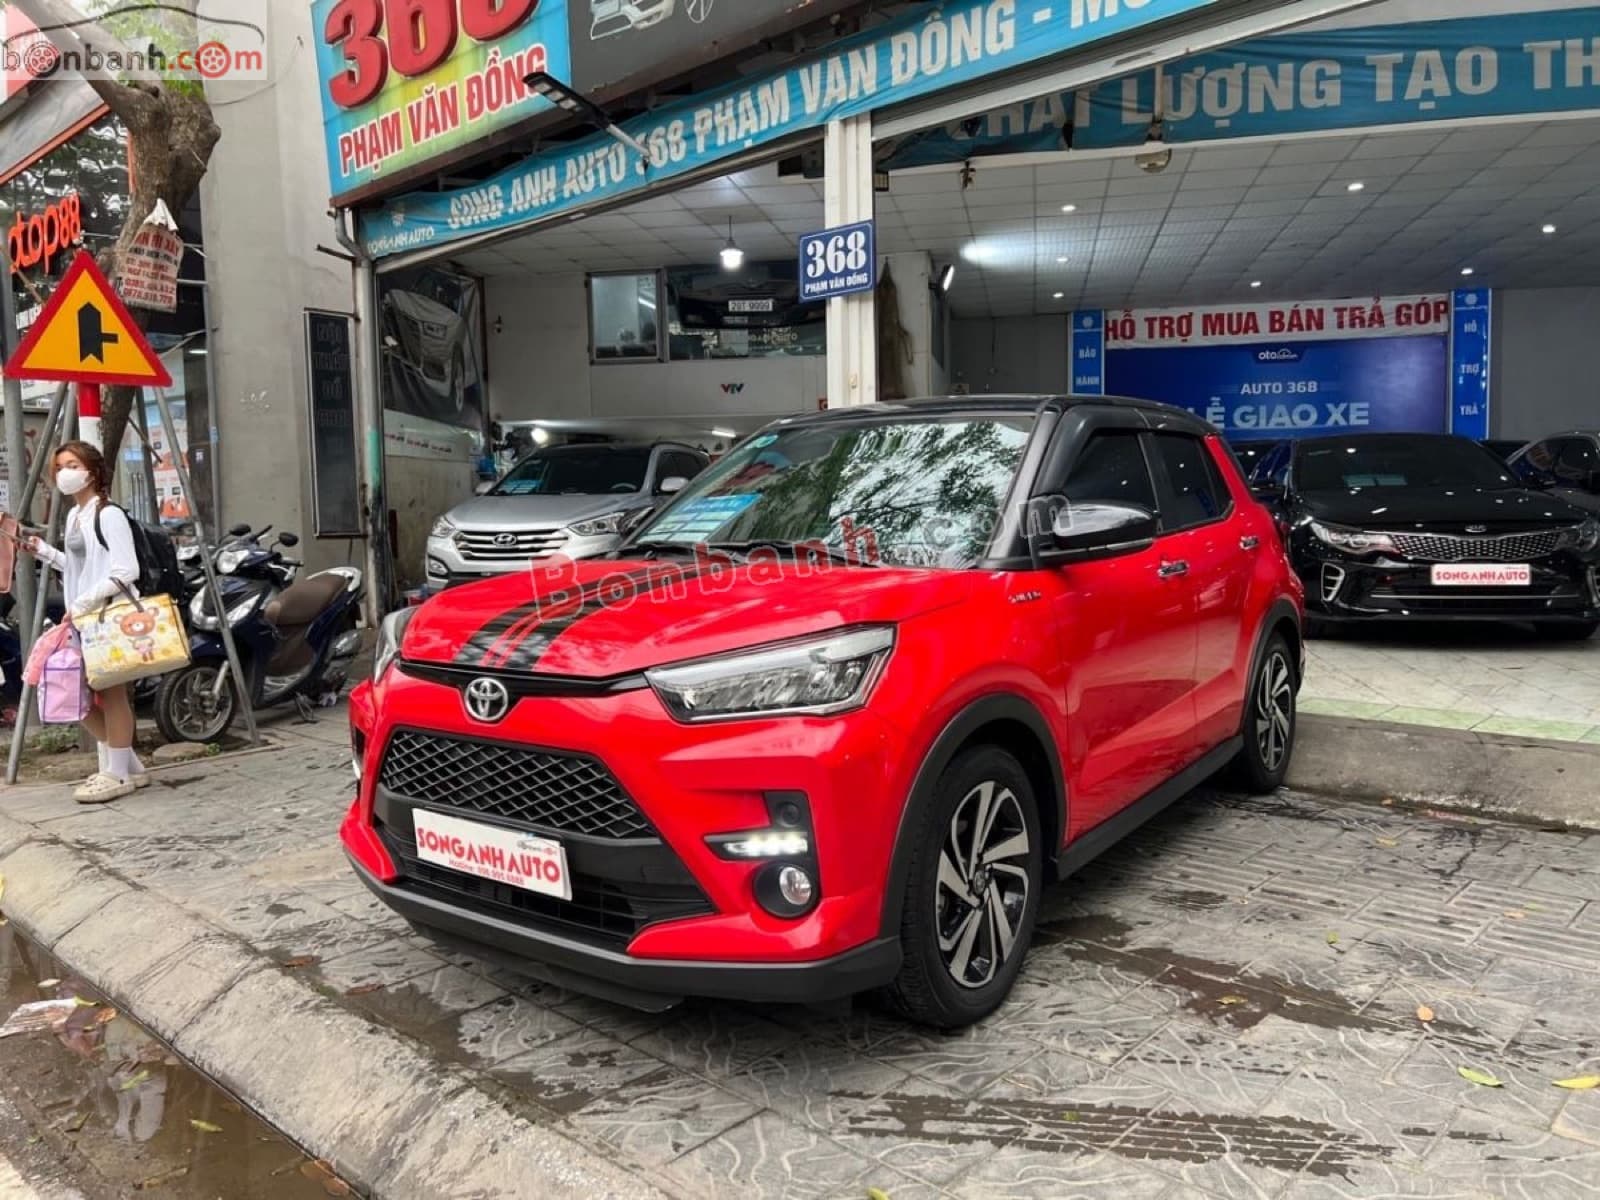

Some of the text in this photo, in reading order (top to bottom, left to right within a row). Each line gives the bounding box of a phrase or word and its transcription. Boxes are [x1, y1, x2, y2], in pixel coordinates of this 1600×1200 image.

[340, 46, 546, 176] PHẠM VĂN ĐỒNG
[1120, 60, 1342, 129] LƯỢNG
[1365, 45, 1499, 111] TẠO
[448, 184, 504, 229] SONG
[508, 165, 557, 214] ANH
[563, 142, 627, 198] AUTO
[806, 231, 867, 278] 368
[1105, 293, 1449, 343] HỖ TRỢ MUA BÁN TRẢ GÓP
[721, 383, 744, 394] VTV
[1240, 381, 1318, 395] AUTO 368
[1232, 403, 1318, 429] GIAO
[1325, 402, 1370, 427] XE
